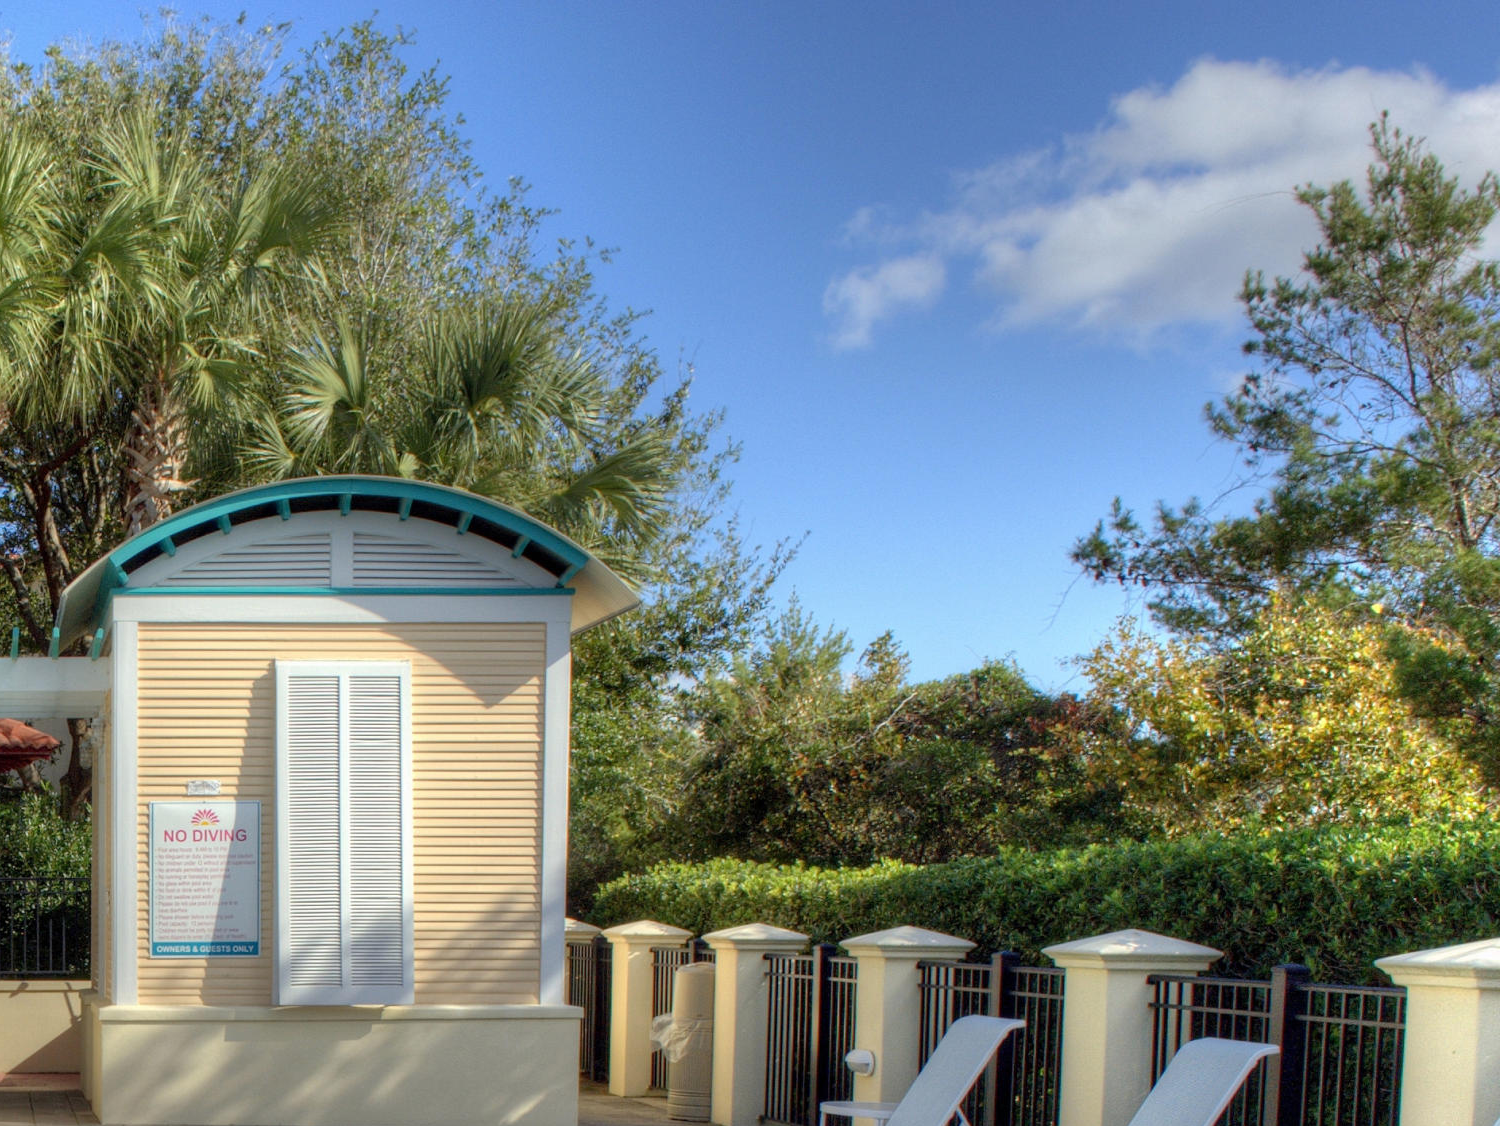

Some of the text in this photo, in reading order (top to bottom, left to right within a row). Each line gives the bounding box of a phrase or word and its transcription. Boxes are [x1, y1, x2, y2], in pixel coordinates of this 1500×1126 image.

[163, 828, 247, 842] NO DIVING
[156, 944, 254, 953] OWNERS & GUESTS ONLY
